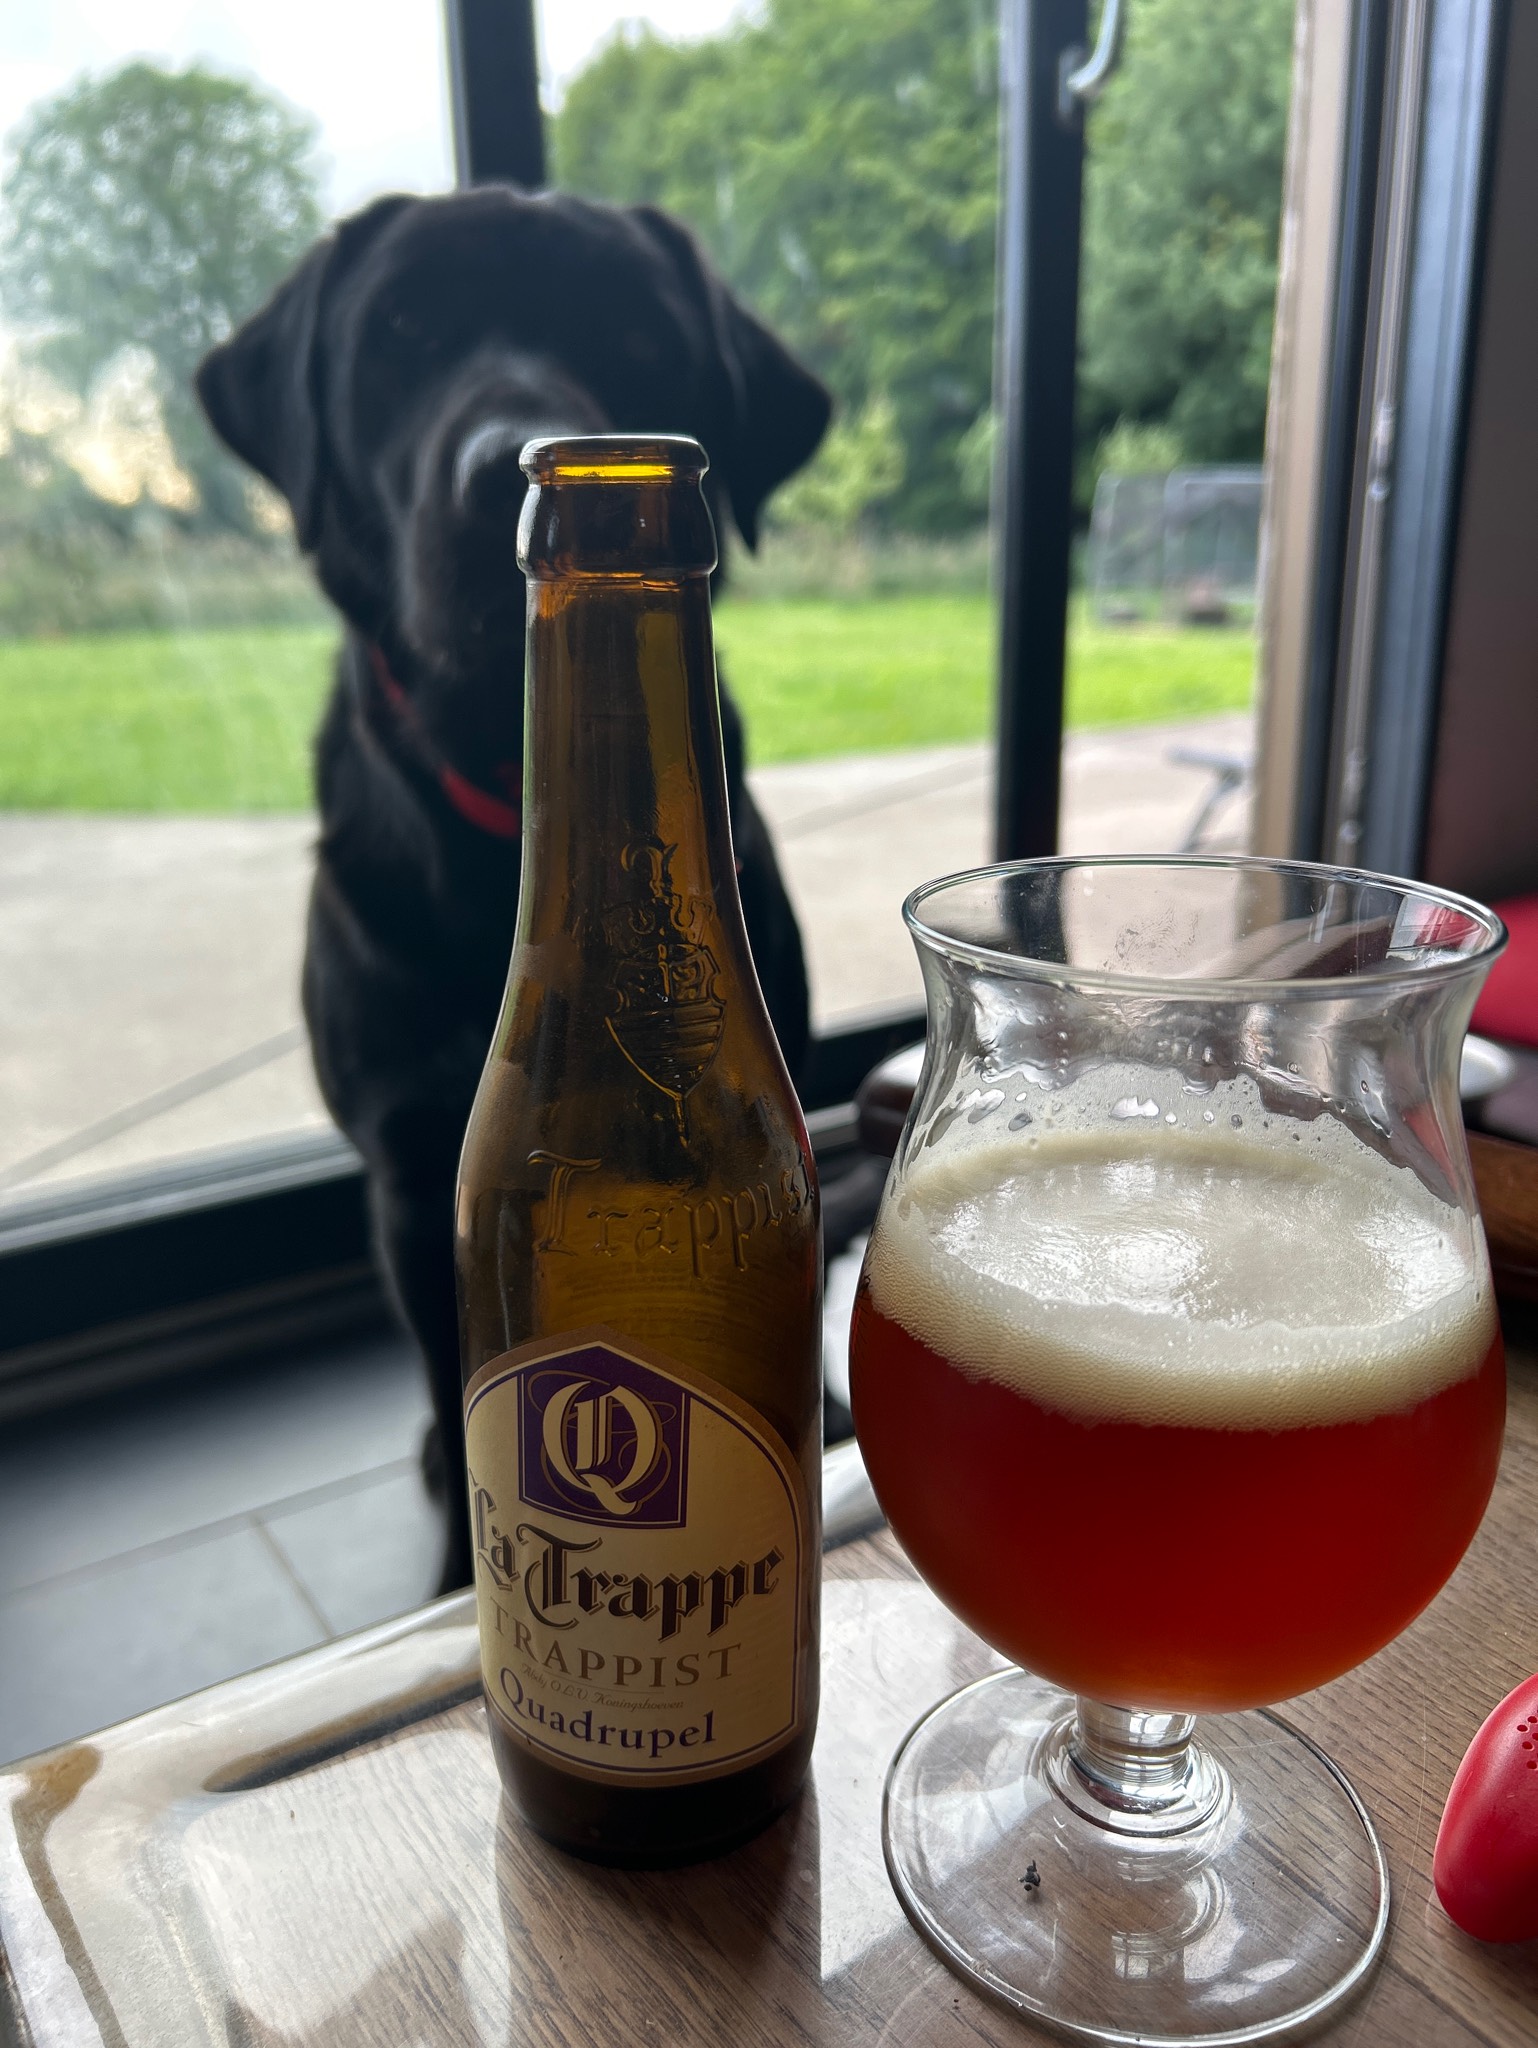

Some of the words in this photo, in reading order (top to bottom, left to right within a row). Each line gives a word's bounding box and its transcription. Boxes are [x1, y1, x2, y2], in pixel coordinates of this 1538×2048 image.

[542, 1379, 663, 1515] Q
[468, 1467, 521, 1592] La
[516, 1521, 785, 1642] Trappe
[489, 1597, 742, 1688] TRAPPIST
[500, 1666, 717, 1759] Quadrupel
[593, 1690, 685, 1713] Koningshoeven
